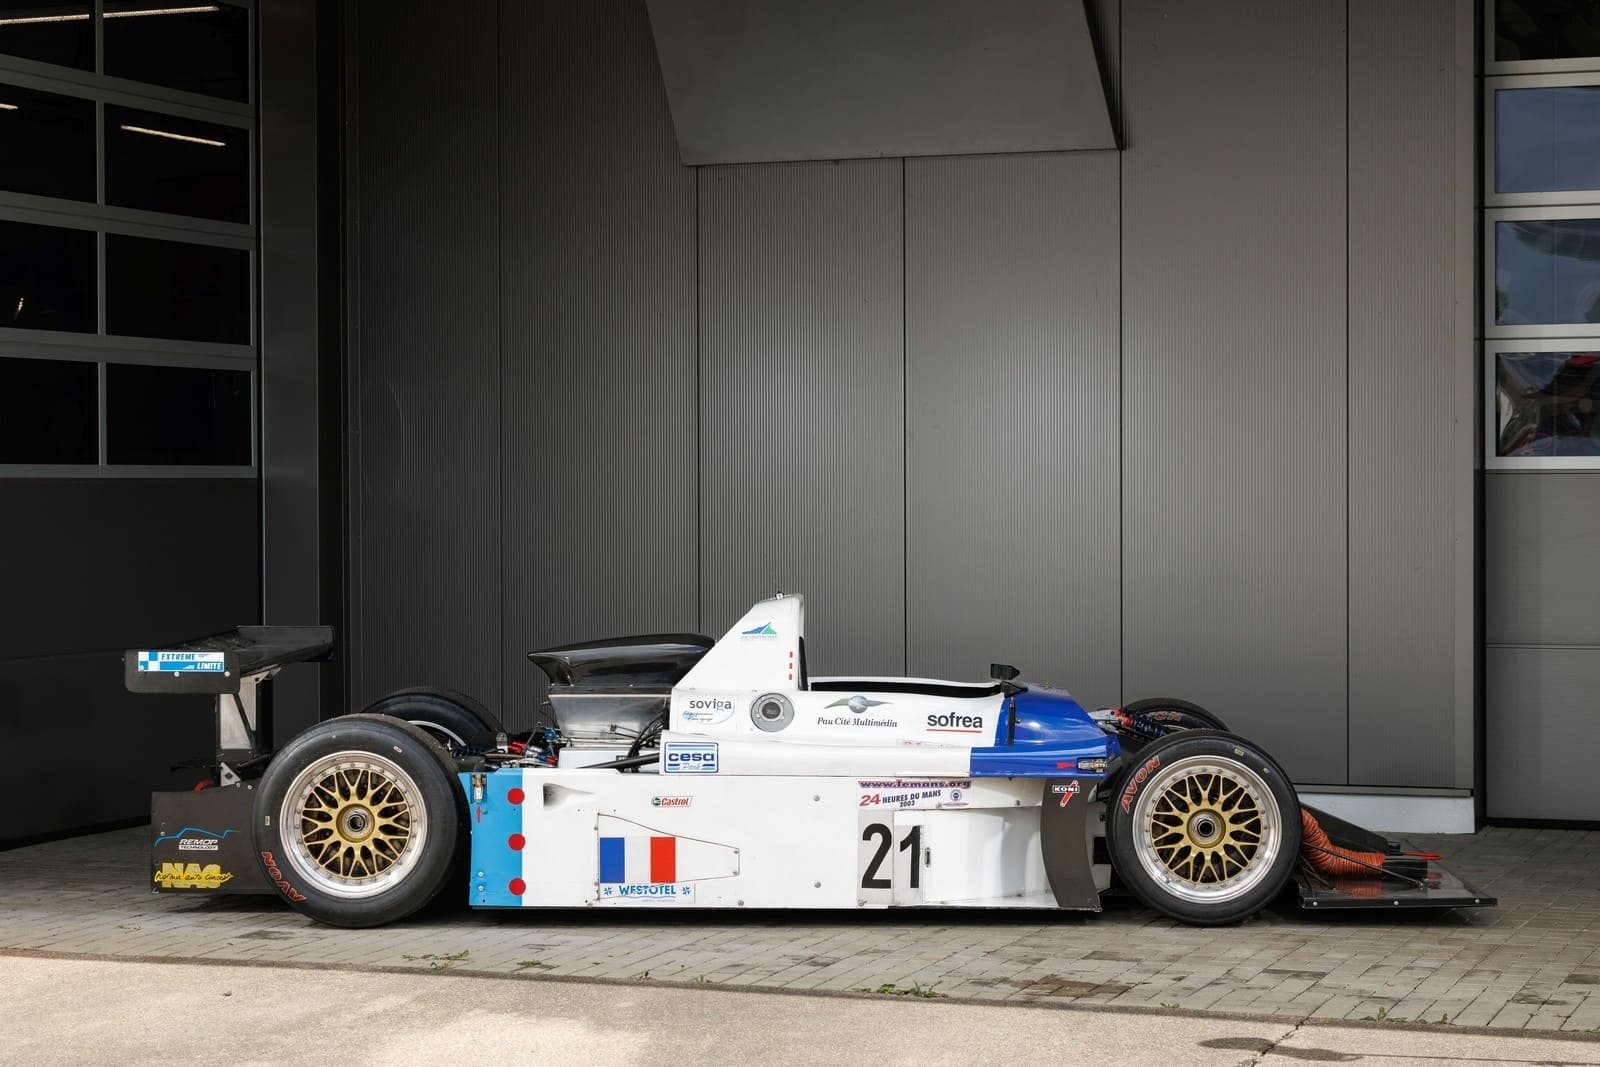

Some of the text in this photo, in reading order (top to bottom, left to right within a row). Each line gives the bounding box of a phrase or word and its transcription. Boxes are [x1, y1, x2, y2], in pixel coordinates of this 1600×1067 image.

[161, 653, 195, 661] EXTREME
[197, 662, 222, 670] LIMITE
[689, 698, 732, 711] soviga
[817, 717, 898, 728] Pau Cité Multimédia
[927, 712, 983, 728] sofrea
[668, 753, 714, 761] cesa
[858, 779, 972, 789] www.lemans.org
[1121, 755, 1160, 814] AVON
[661, 797, 689, 806] Castrol
[859, 789, 941, 806] 24 HEURES DU MANS
[179, 838, 218, 846] REMOP
[861, 823, 921, 889] 21
[261, 851, 307, 901] AVON
[619, 885, 677, 895] WESTOTEL
